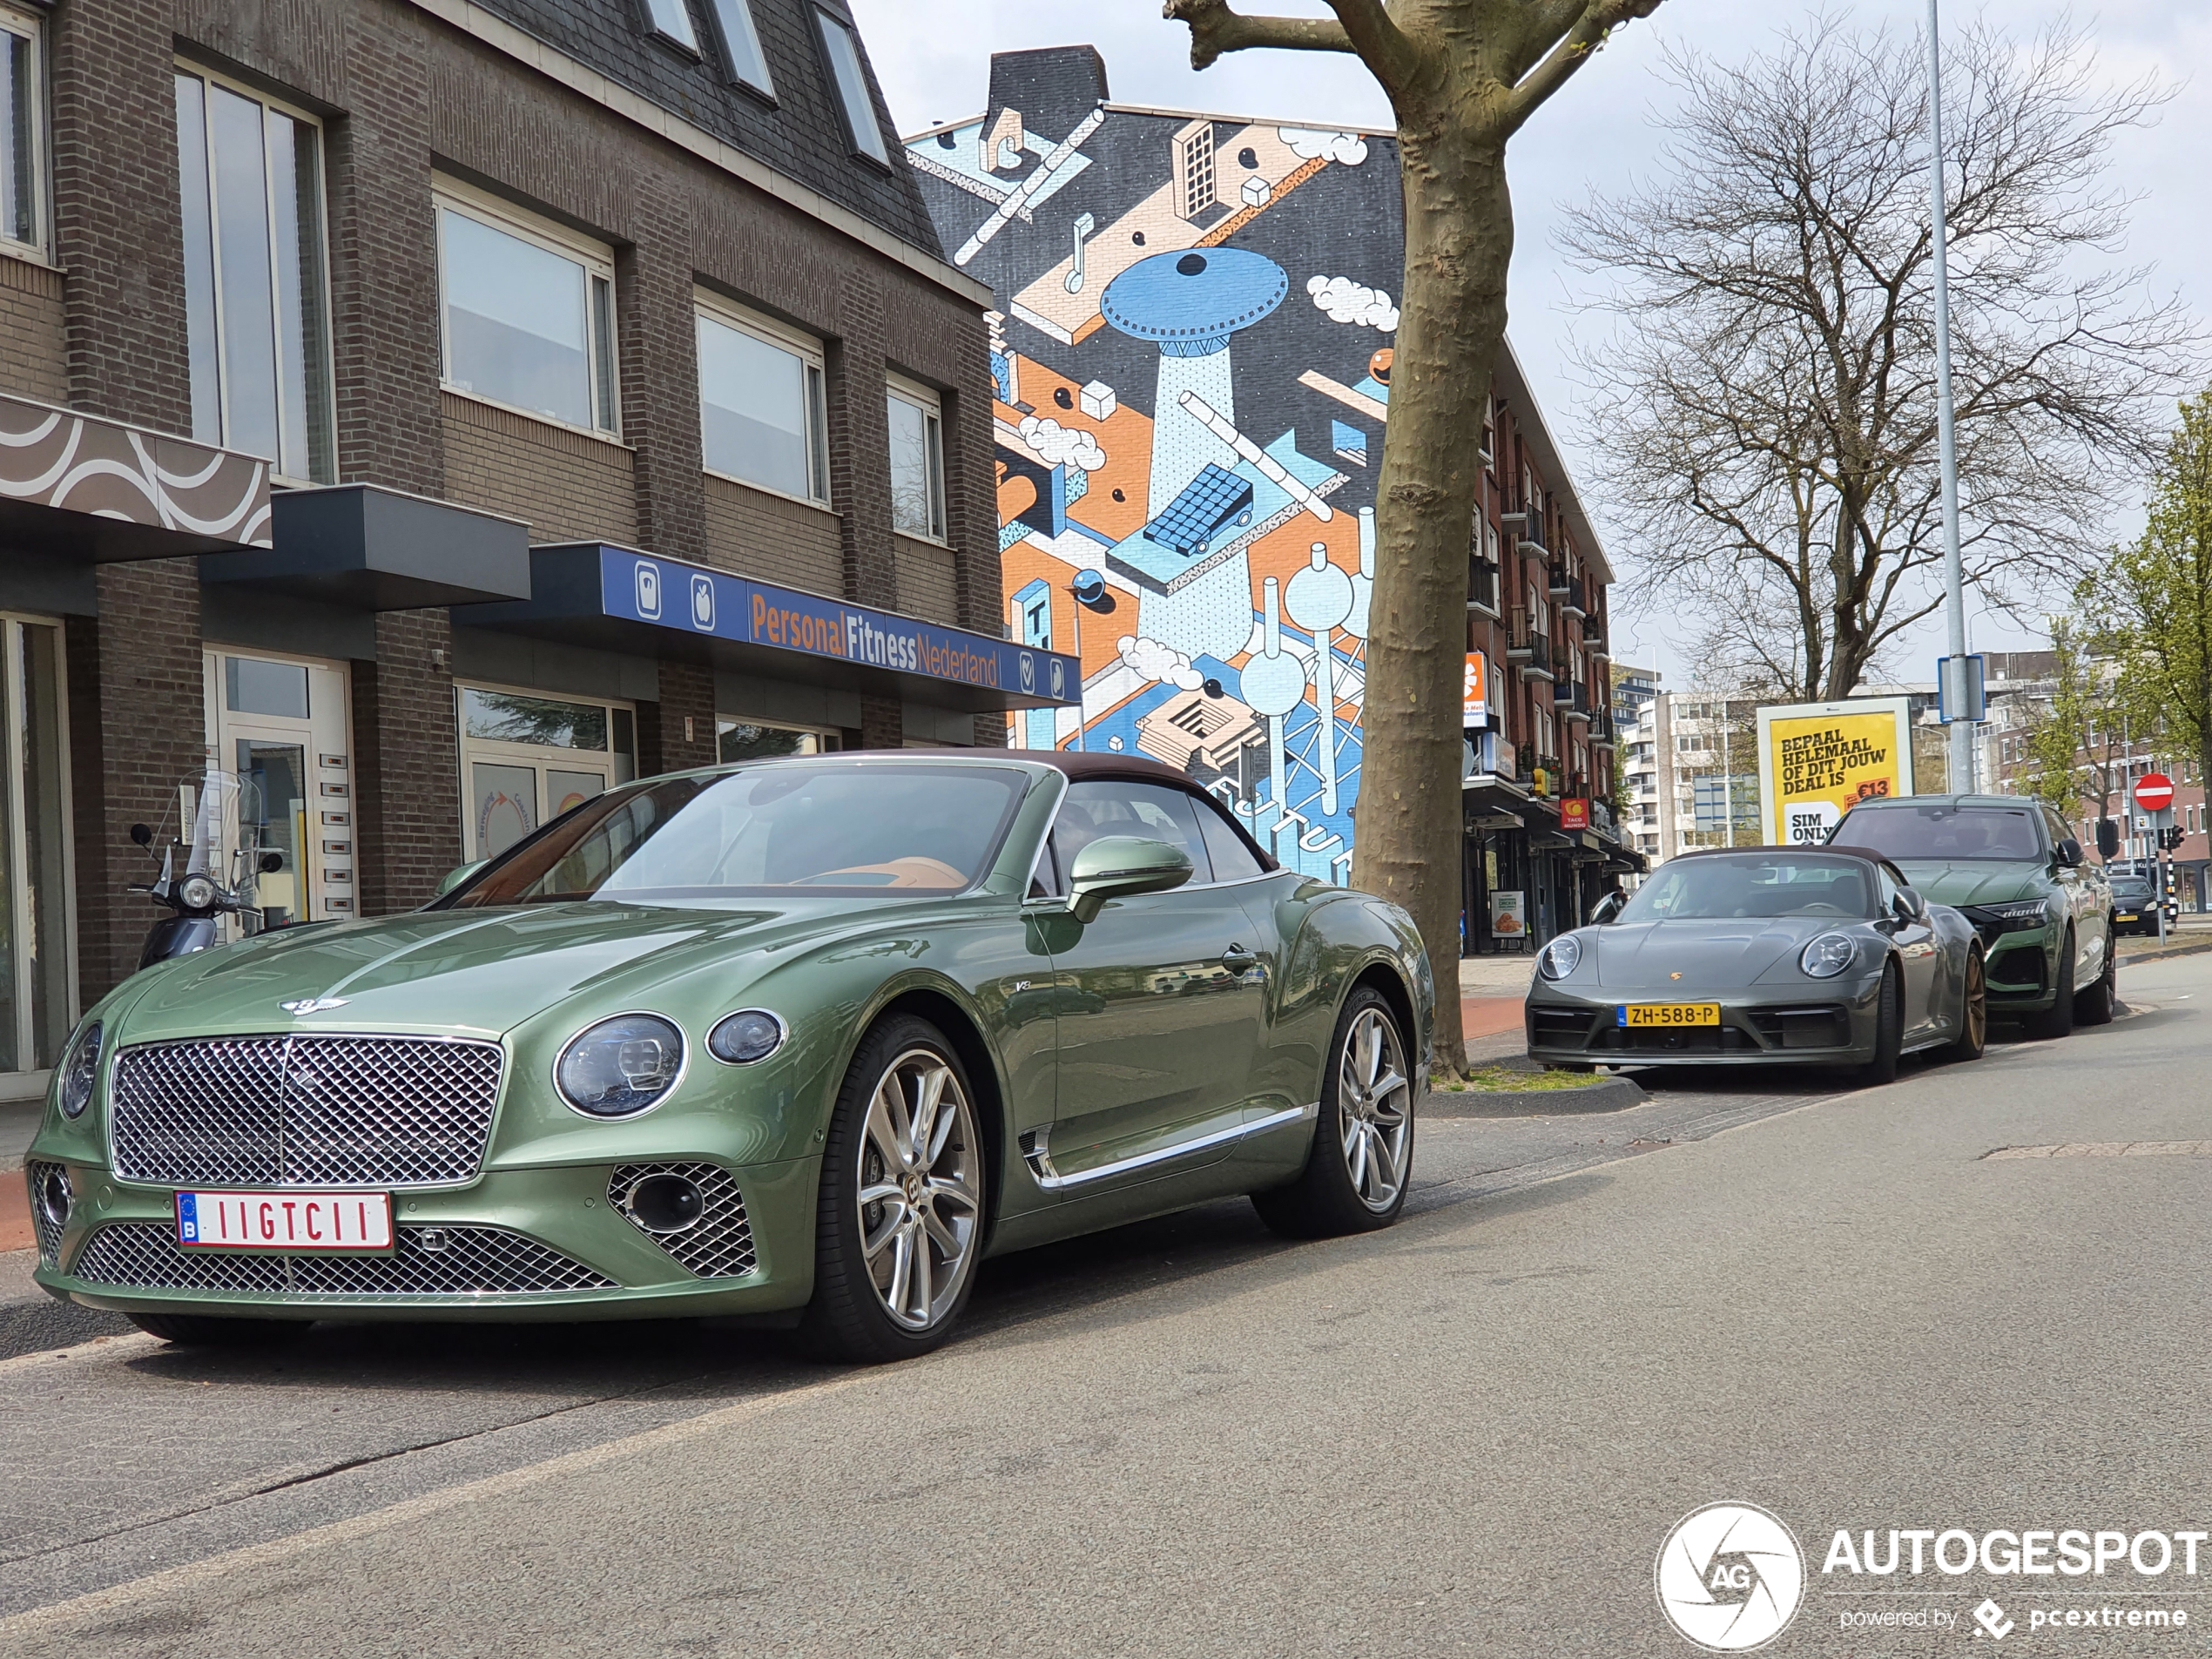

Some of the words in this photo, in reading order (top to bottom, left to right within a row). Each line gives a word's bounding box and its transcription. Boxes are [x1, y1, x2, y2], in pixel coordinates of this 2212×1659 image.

[1781, 729, 1844, 753] BEPAAL
[1782, 738, 1871, 767] HELEMAAL
[1783, 765, 1804, 781] OF
[1808, 759, 1836, 777] DIT
[1840, 748, 1886, 771] JOUW
[1783, 776, 1825, 796] DEAL
[1829, 772, 1845, 787] IS
[514, 793, 530, 834] Coachin
[1792, 813, 1822, 827] SIM
[1016, 981, 1031, 992] V8
[1350, 993, 1367, 1015] ZERO
[1631, 1007, 1713, 1023] ZH-588-P
[184, 1222, 196, 1238] B
